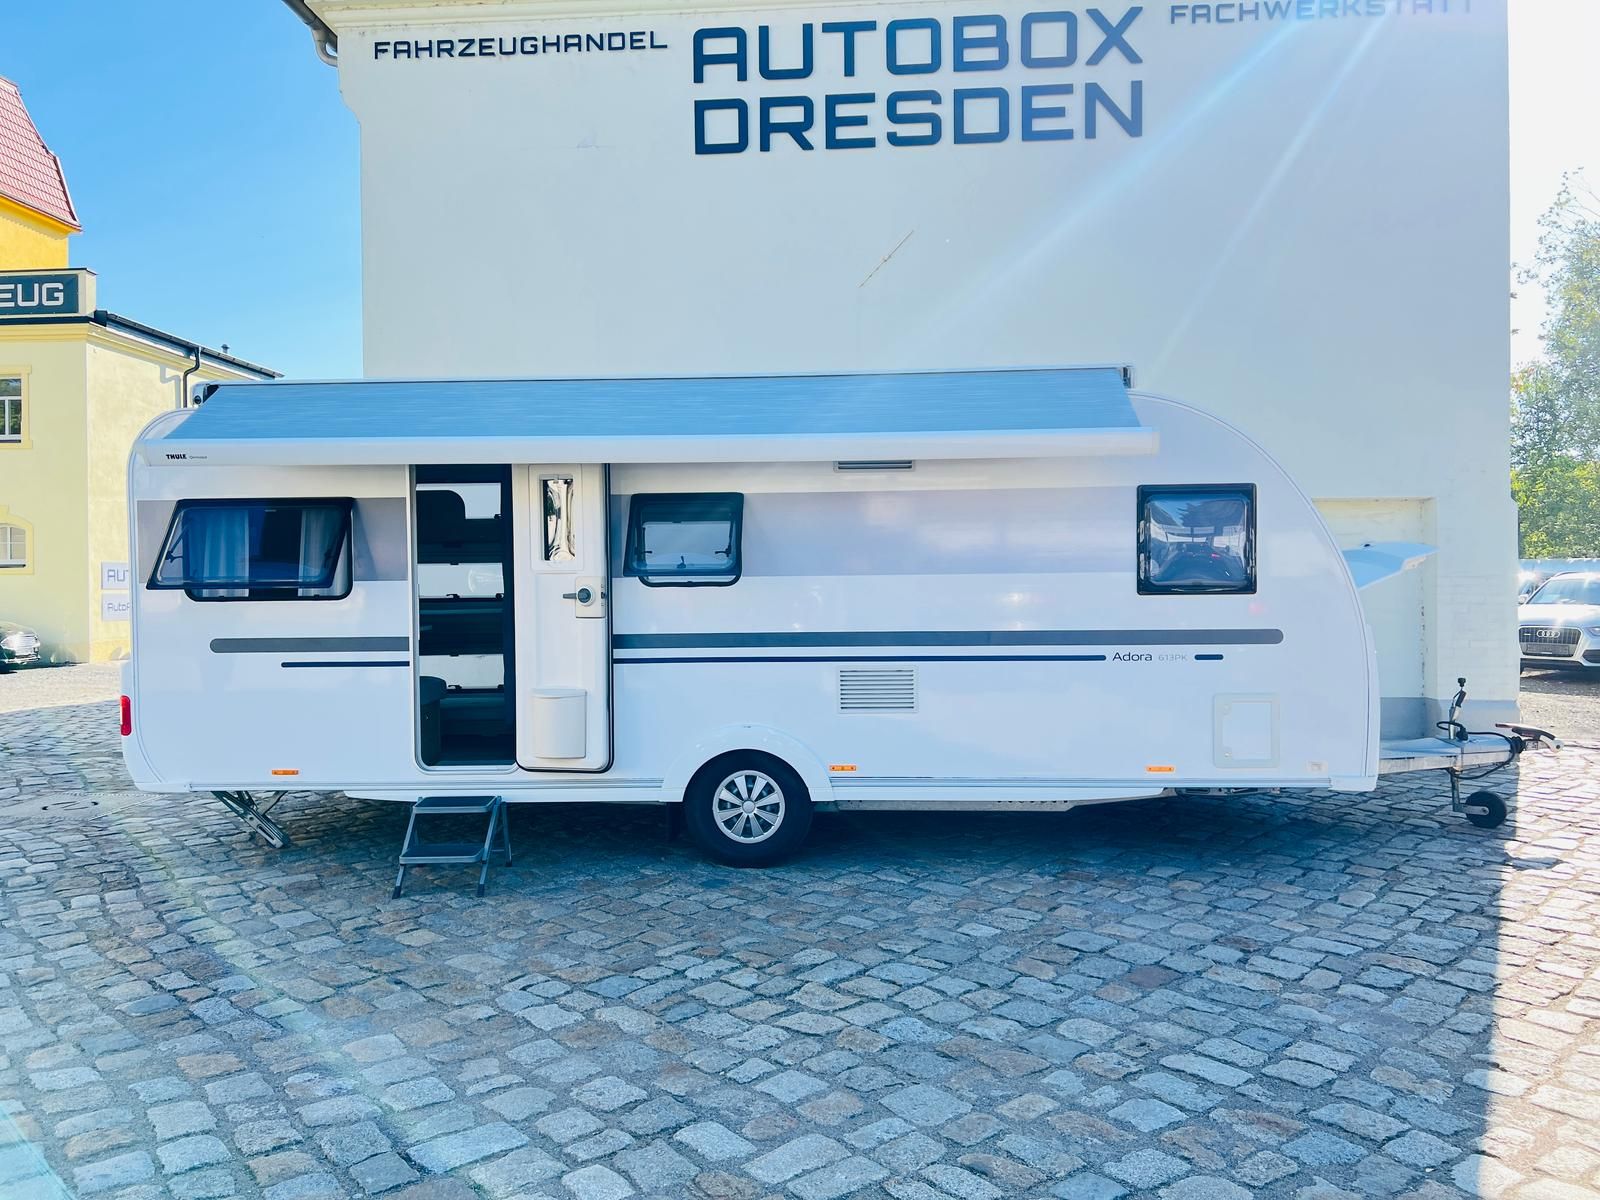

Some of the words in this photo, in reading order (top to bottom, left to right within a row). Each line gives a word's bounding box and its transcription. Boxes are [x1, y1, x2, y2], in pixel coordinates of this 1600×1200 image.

[374, 31, 668, 60] FAHRZEUGHANDEL
[693, 6, 1143, 83] AUTOBOX
[694, 80, 1143, 155] DRESDEN
[0, 282, 64, 307] EUG
[1112, 651, 1153, 662] Adora
[1158, 653, 1189, 661] 613PK
